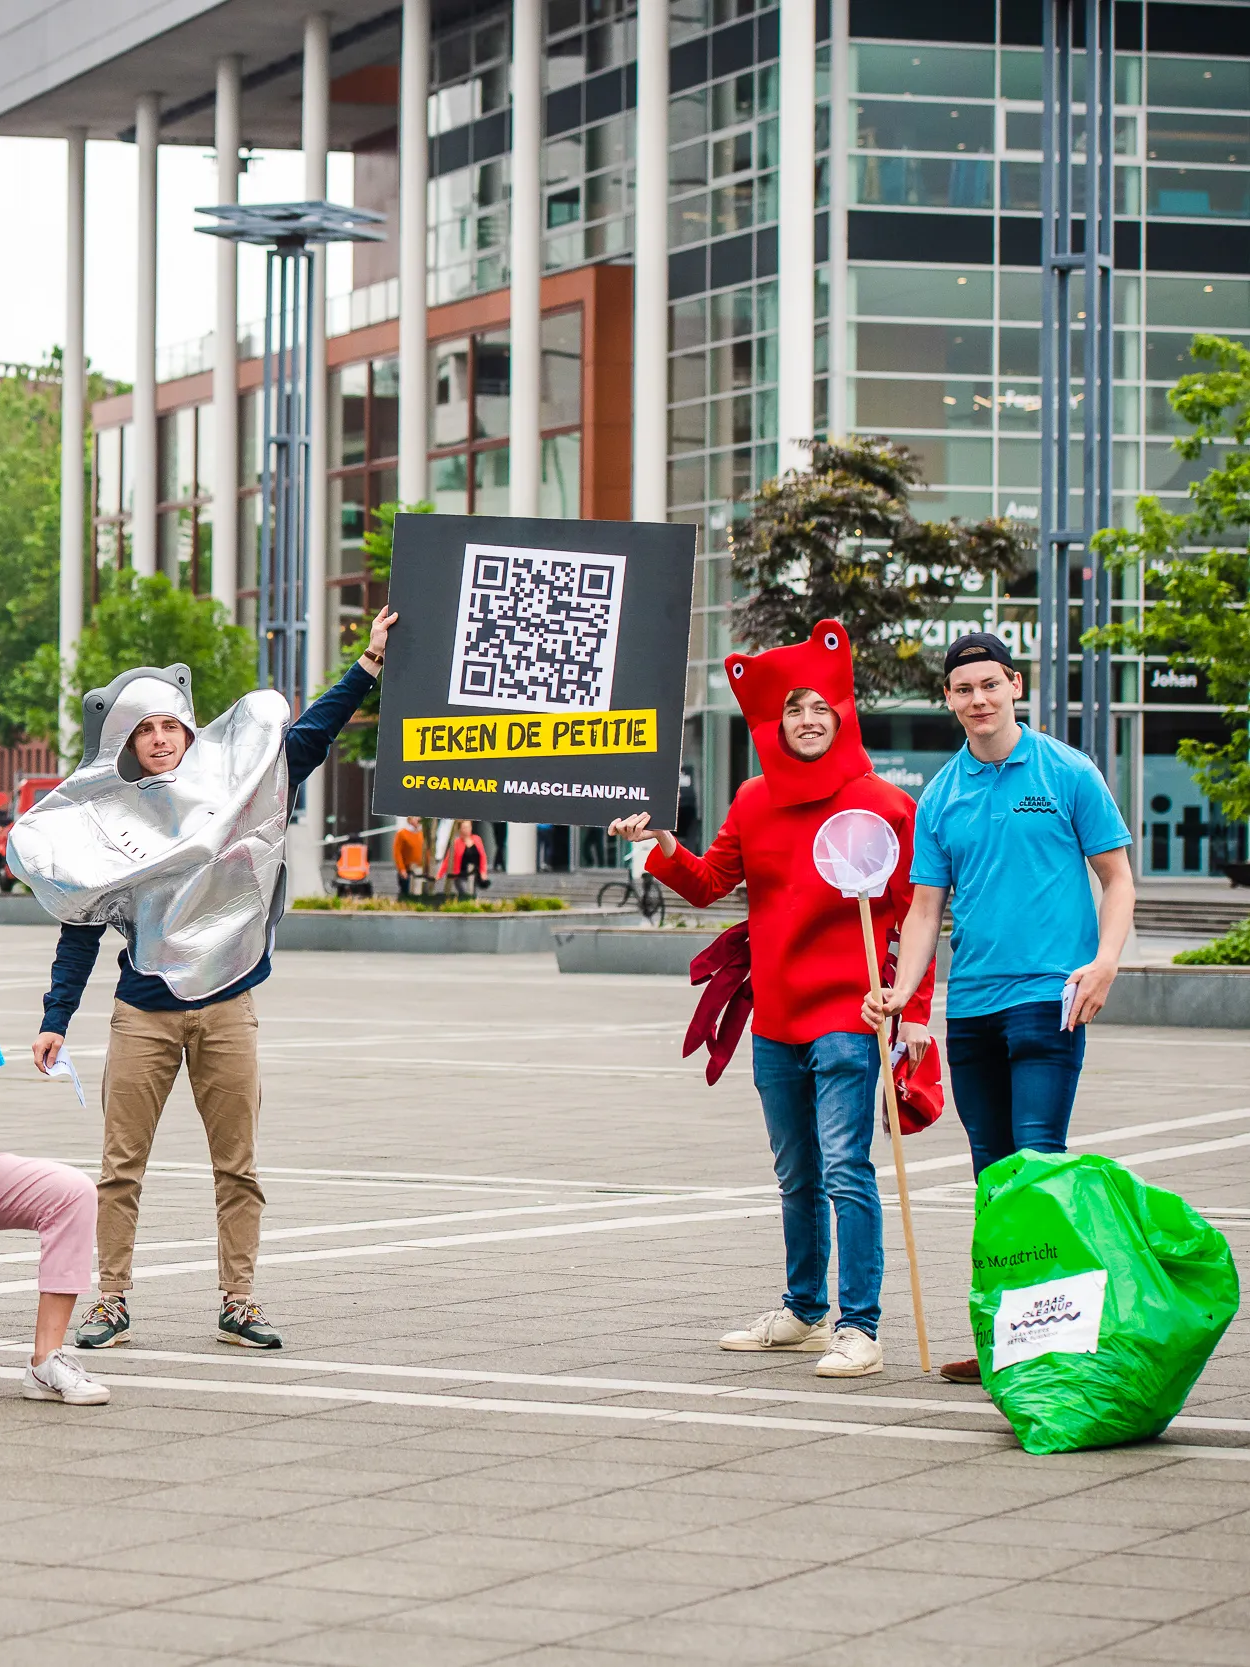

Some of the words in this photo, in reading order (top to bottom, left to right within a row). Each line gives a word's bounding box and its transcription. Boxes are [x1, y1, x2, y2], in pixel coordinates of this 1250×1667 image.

[1151, 669, 1198, 689] Johan
[416, 722, 497, 755] TEKEN
[507, 722, 542, 750] DE
[553, 718, 647, 750] PETITIE
[402, 775, 426, 789] OF
[427, 776, 451, 790] GA
[452, 777, 498, 793] NAAR
[503, 780, 650, 801] MAASCLEANUP.NL
[1022, 1301, 1073, 1319] CLEANUP
[1033, 1294, 1066, 1309] MAAS
